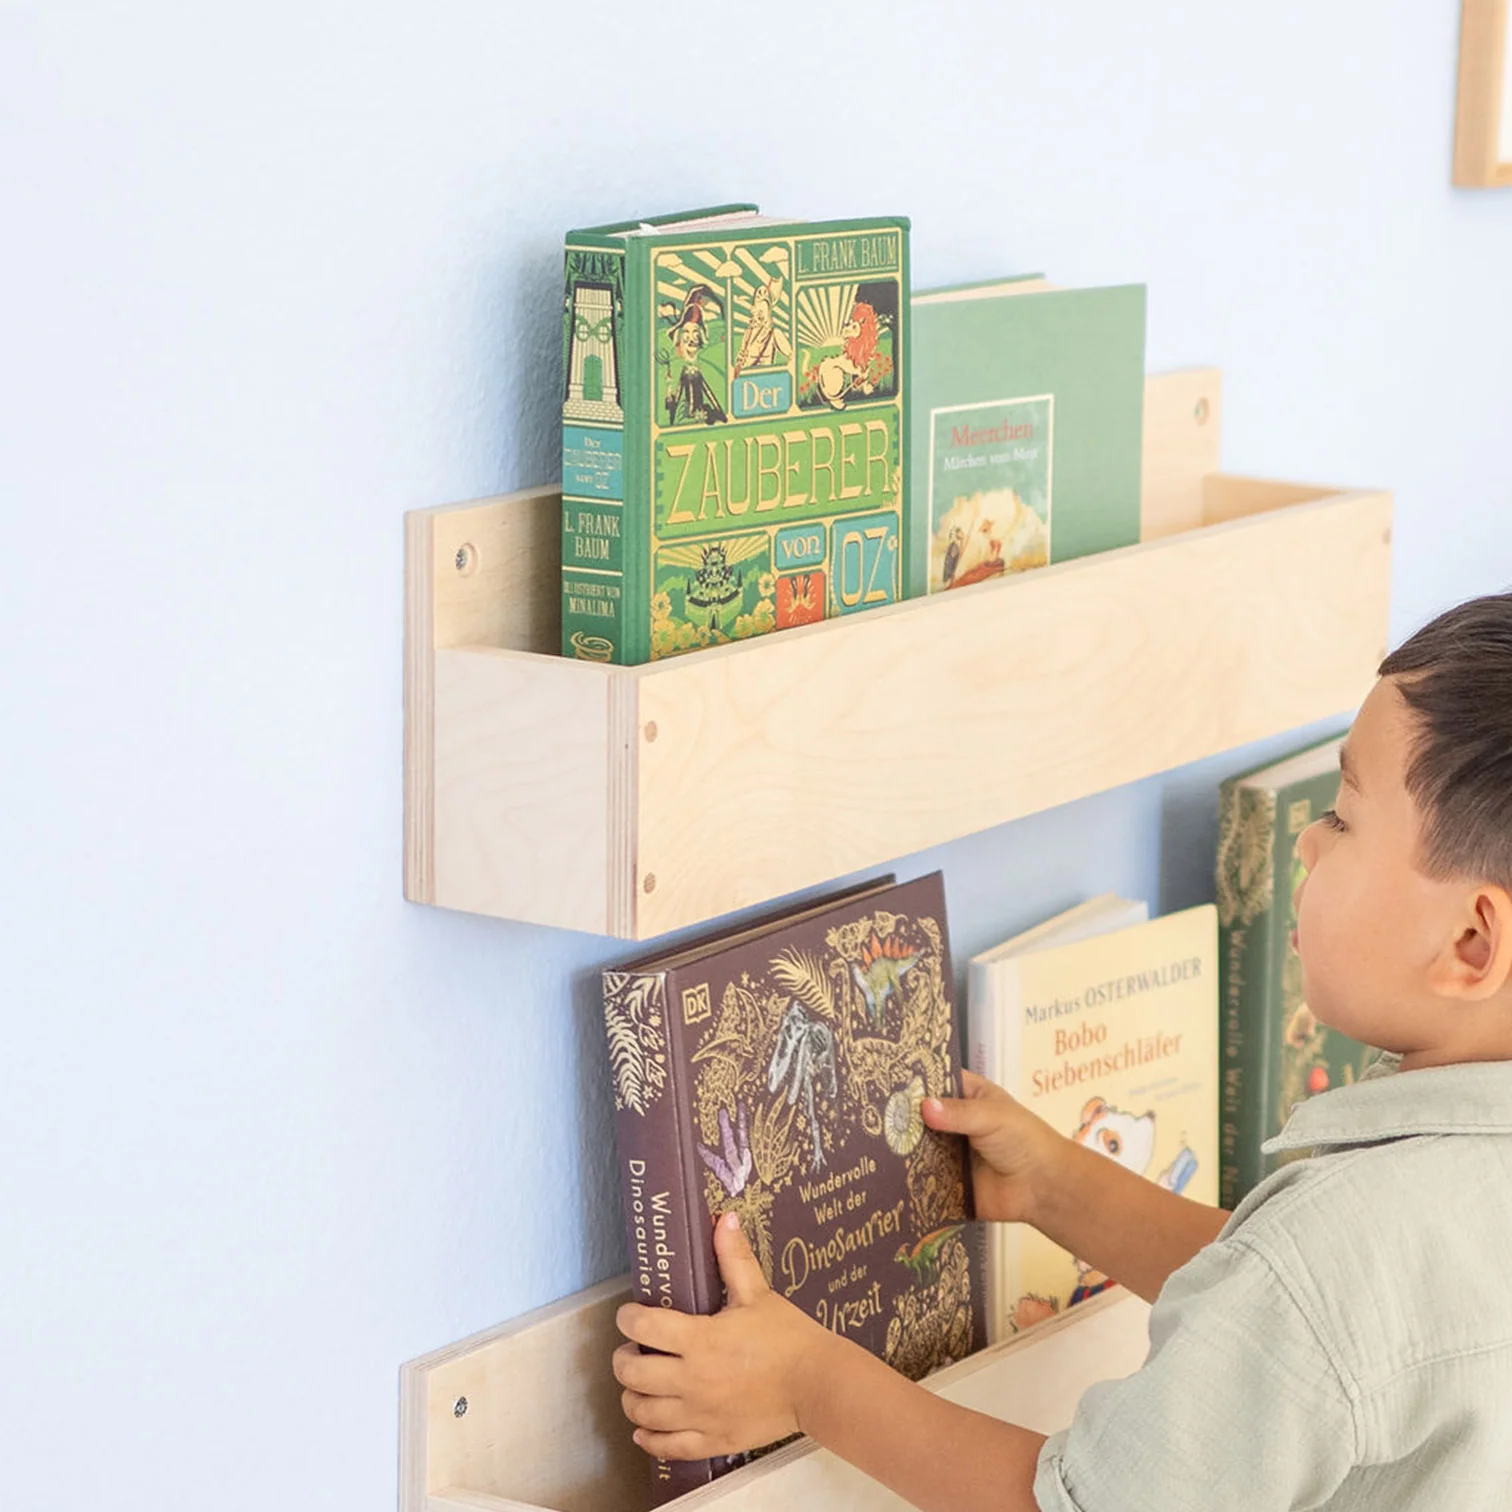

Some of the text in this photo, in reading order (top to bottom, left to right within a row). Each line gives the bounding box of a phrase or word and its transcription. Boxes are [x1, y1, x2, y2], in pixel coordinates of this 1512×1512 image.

[797, 235, 897, 273] L. FRANK BAUM
[742, 380, 783, 411] Der
[665, 419, 895, 526] ZAUBERER
[574, 535, 609, 560] BAUM
[578, 512, 620, 538] FRANK
[781, 526, 890, 607] von OZ
[1024, 956, 1203, 1025] Markus OSTERWALDER
[1054, 1020, 1108, 1056] Bobo
[1031, 1031, 1184, 1097] Siebenschläfer
[799, 1156, 877, 1204] Wundervolle
[629, 1159, 653, 1297] Dinosaurier
[814, 1190, 867, 1226] Welt der
[650, 1191, 677, 1309] Wundervo
[781, 1199, 905, 1297] Dinosaurier
[828, 1263, 868, 1293] und der
[816, 1280, 882, 1335] Urzeit
